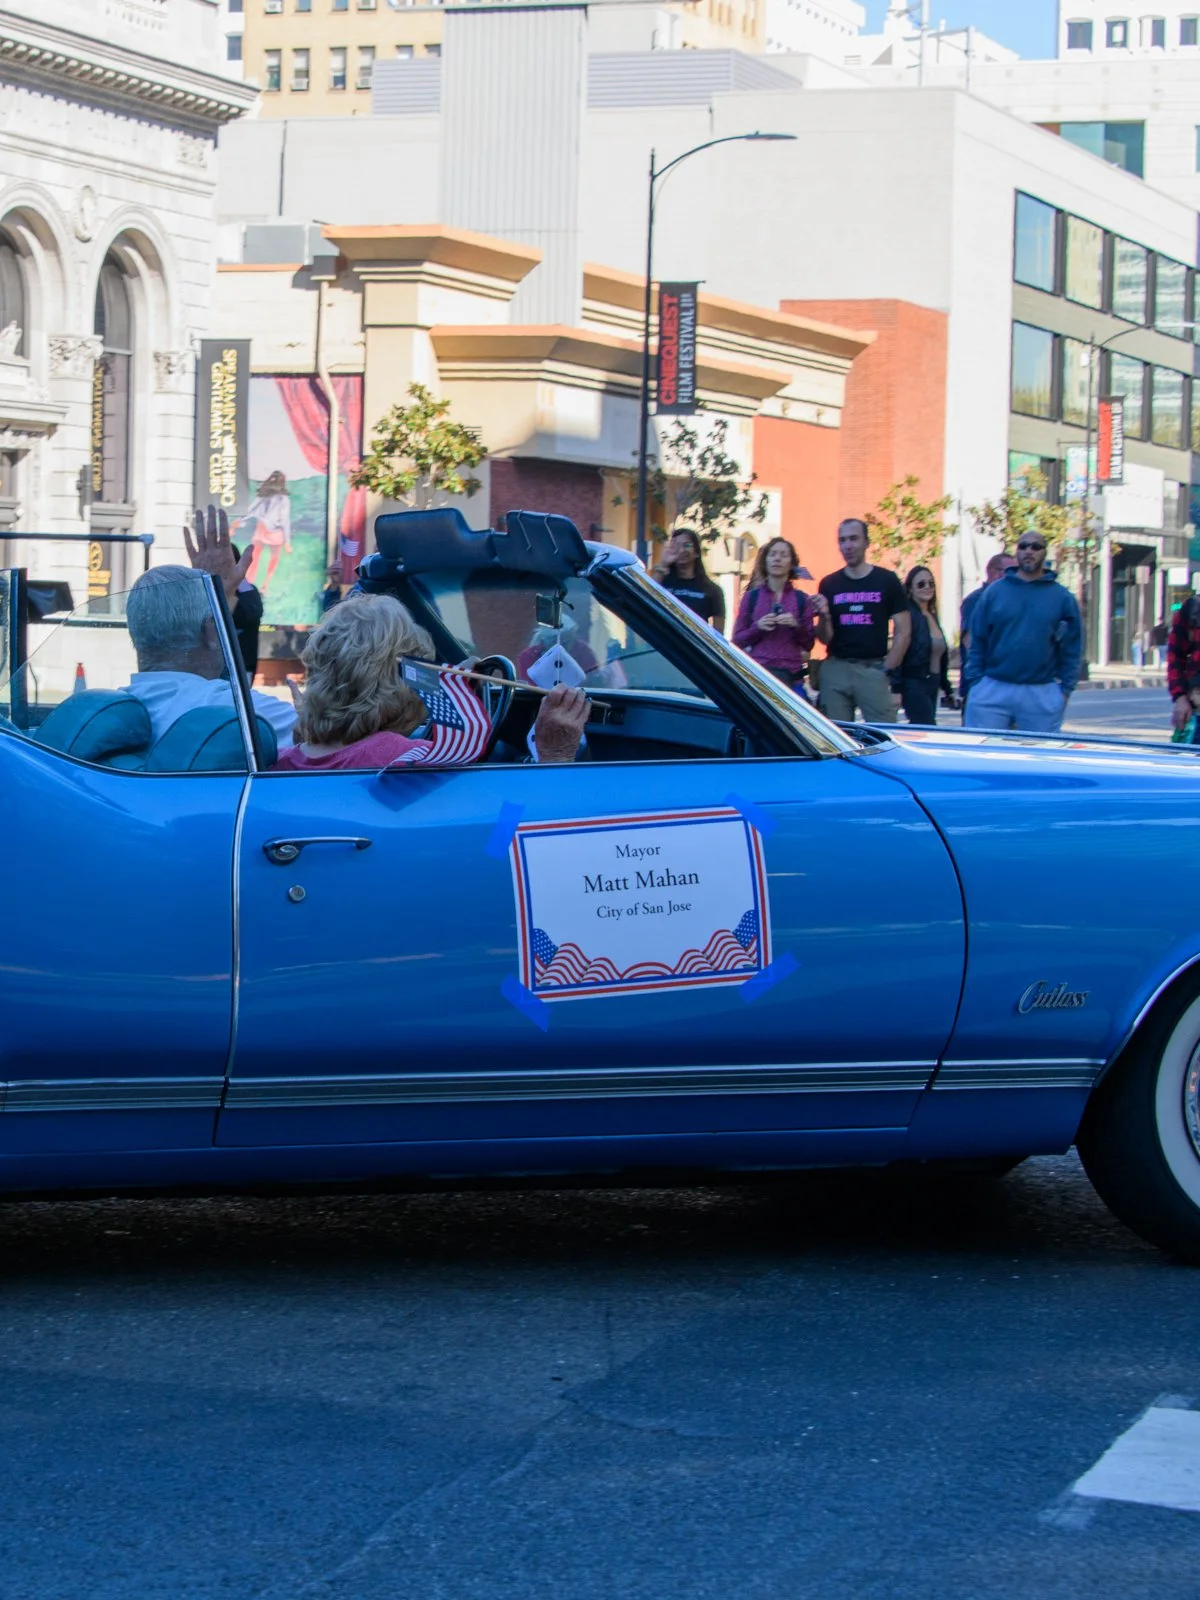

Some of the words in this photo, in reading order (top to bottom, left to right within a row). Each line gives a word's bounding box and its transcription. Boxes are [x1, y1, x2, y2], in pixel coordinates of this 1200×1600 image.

[660, 293, 678, 405] CINEQUEST
[679, 309, 695, 368] FESTIVAL
[223, 349, 237, 435] SPEARMINT
[678, 372, 693, 403] FILM
[220, 456, 237, 507] RHINO
[615, 844, 661, 861] Mayor
[584, 874, 629, 893] Matt
[635, 868, 700, 889] Mahan
[596, 905, 622, 920] City
[626, 902, 640, 916] of
[642, 902, 664, 915] San
[667, 900, 692, 916] Jose
[1019, 980, 1090, 1014] Cutlass
